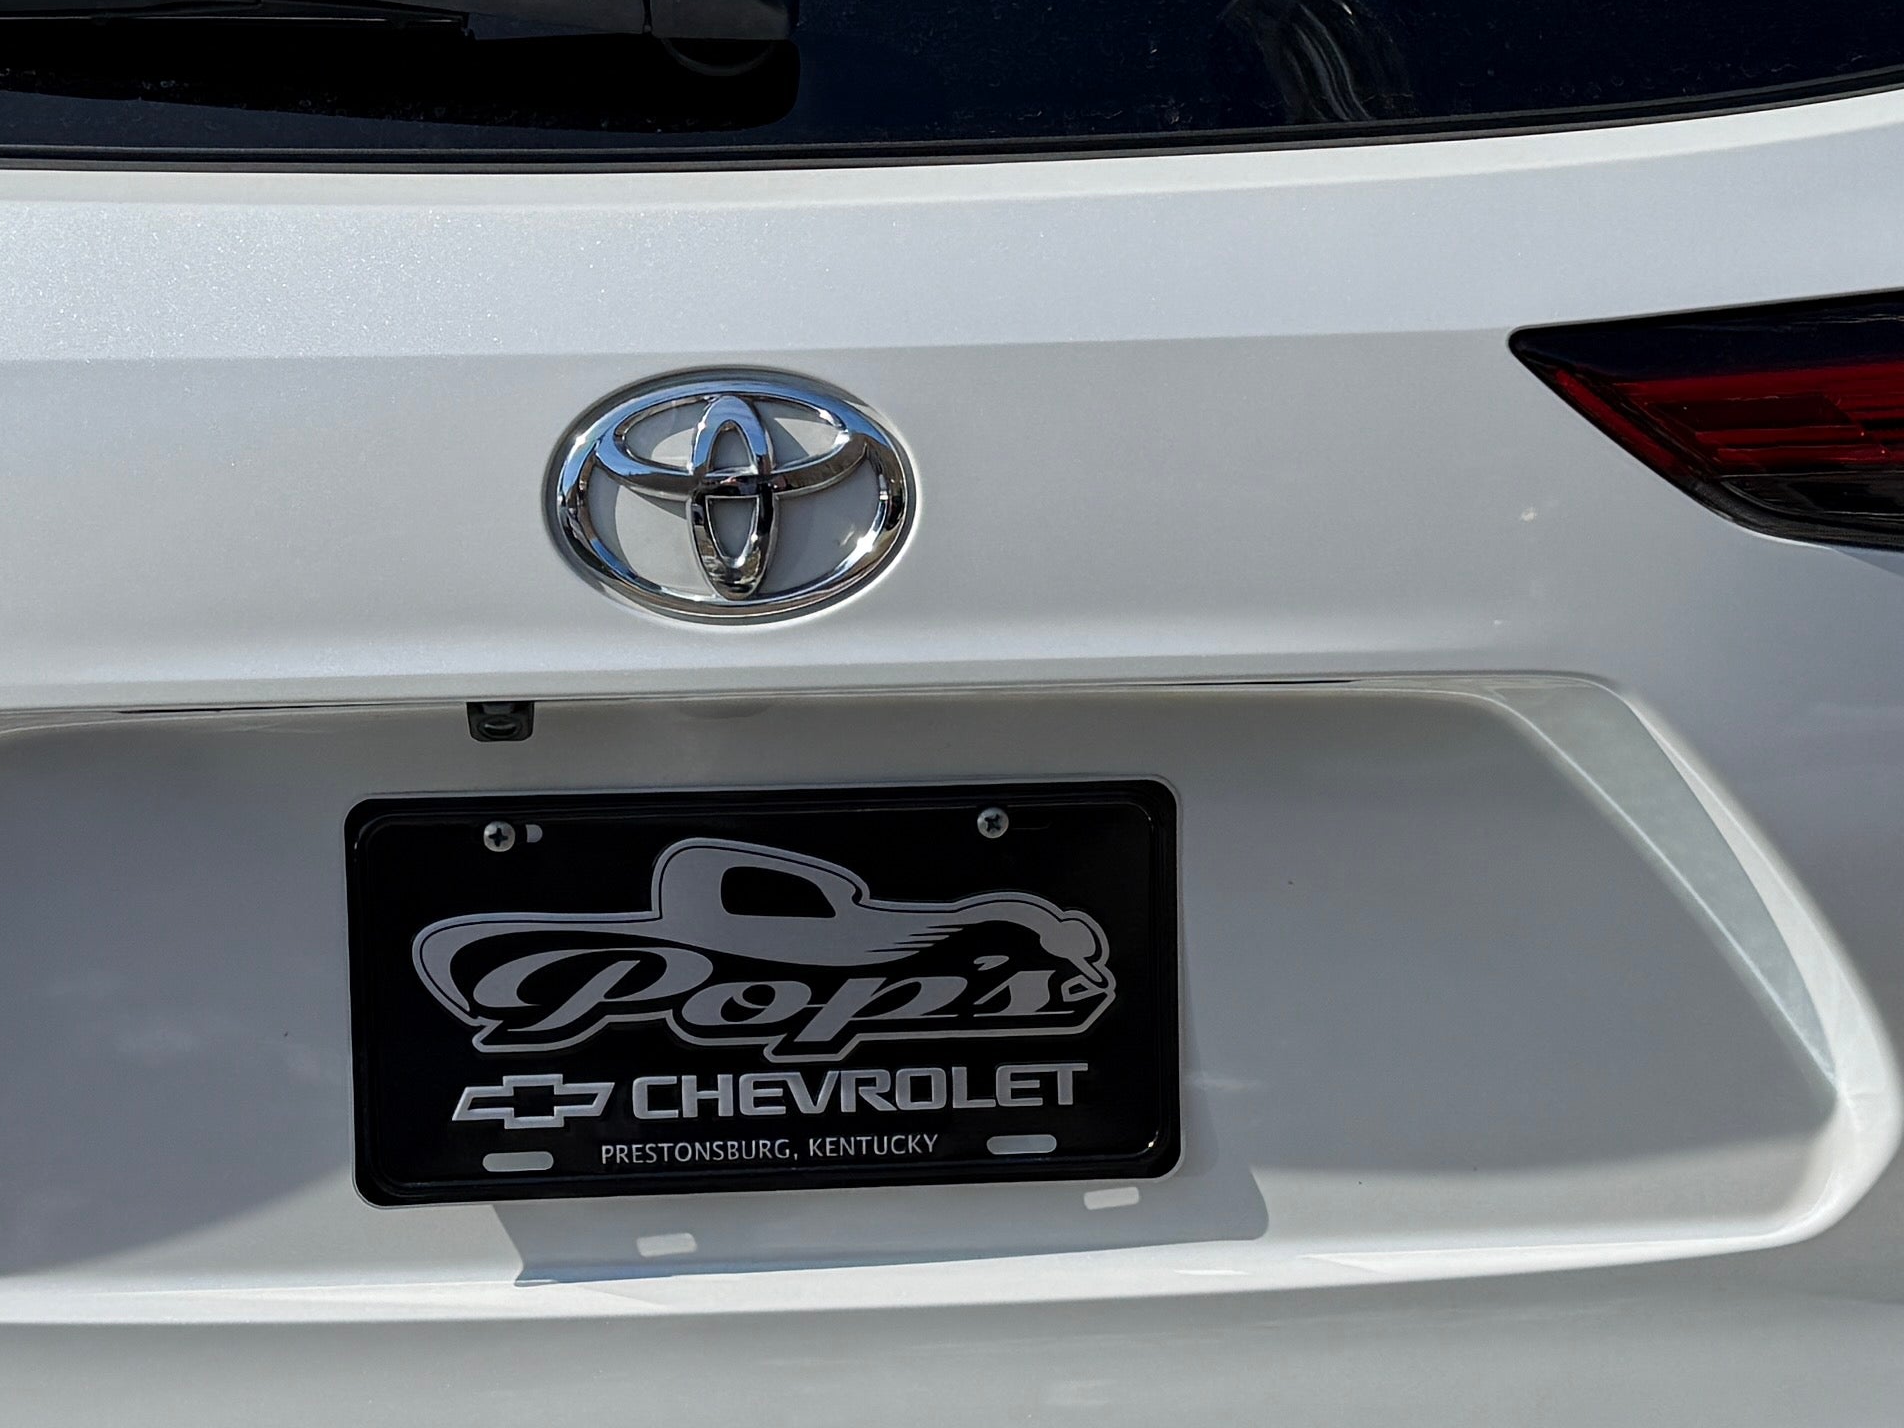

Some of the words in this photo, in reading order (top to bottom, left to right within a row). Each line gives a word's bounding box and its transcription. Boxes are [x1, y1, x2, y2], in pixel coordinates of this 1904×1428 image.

[472, 947, 1076, 1043] Pop's
[632, 1062, 1089, 1120] CHEVROLET
[601, 1138, 799, 1165] PRESTONSBURG,
[808, 1134, 939, 1158] KENTUCKY
